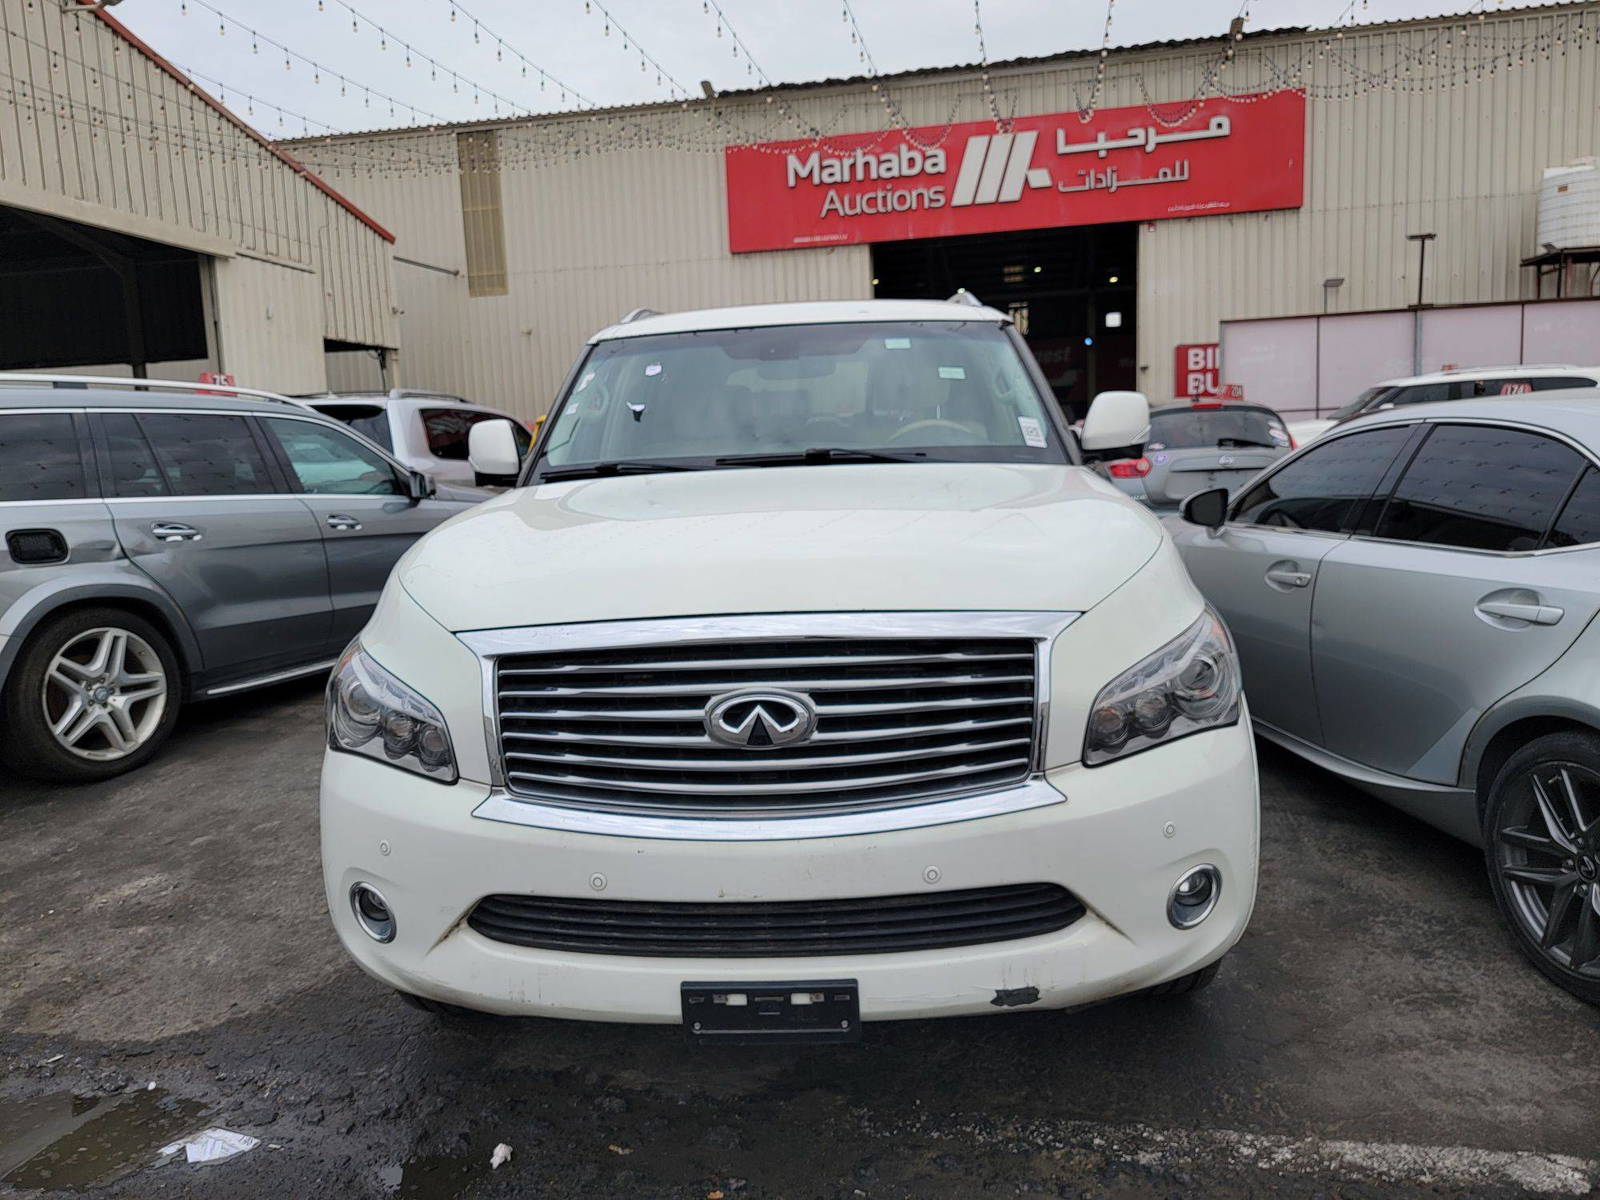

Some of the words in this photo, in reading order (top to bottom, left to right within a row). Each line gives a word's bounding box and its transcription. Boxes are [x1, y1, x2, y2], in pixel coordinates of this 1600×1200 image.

[1056, 115, 1232, 158] مرحبا
[786, 143, 948, 188] Marhaba
[1057, 159, 1190, 193] للمزادات
[819, 184, 946, 218] Auctions
